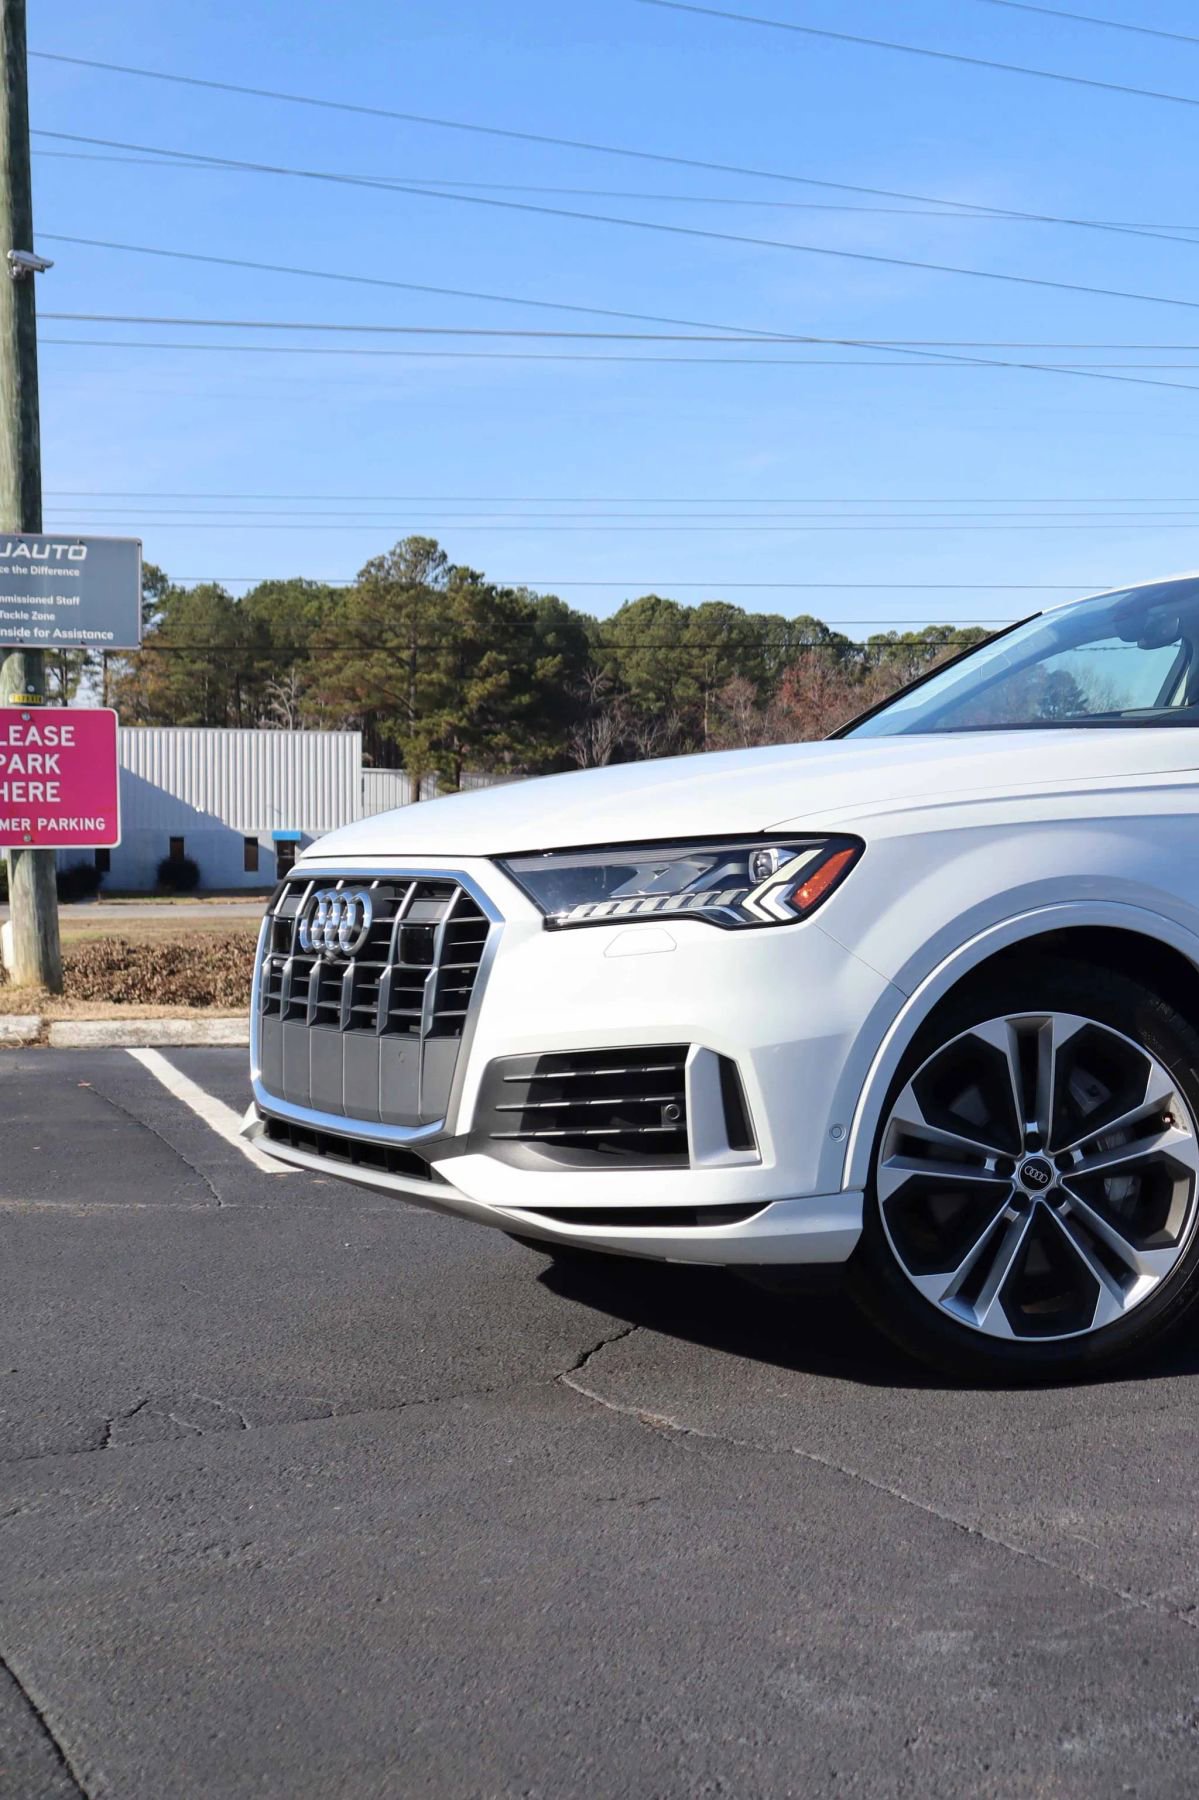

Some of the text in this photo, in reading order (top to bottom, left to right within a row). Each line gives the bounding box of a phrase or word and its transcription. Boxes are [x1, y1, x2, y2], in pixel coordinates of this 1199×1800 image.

[12, 565, 28, 574] the
[30, 565, 80, 576] Difference
[56, 596, 80, 605] Staff
[31, 611, 56, 621] Zone
[33, 627, 50, 638] for
[53, 628, 114, 640] Assistance
[37, 817, 106, 831] PARKING
